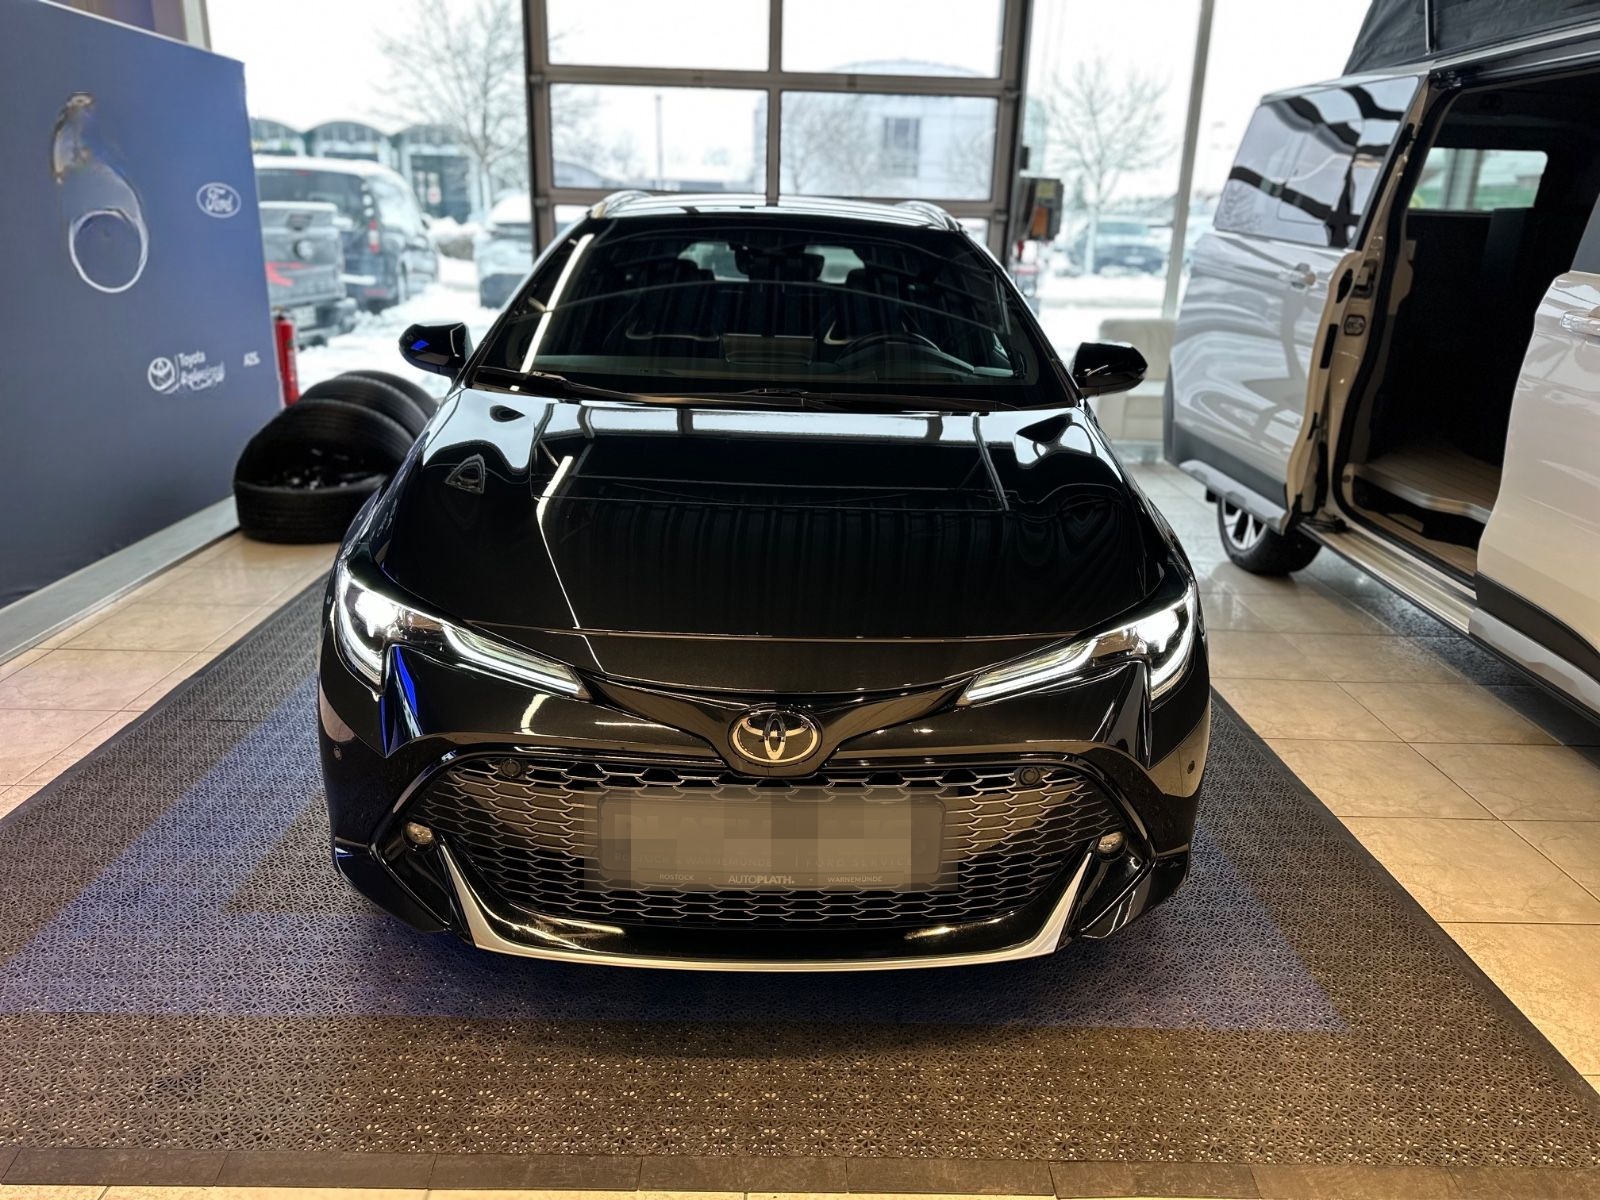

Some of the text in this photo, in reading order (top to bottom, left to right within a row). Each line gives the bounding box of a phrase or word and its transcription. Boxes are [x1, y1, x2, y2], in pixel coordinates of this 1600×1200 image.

[614, 852, 671, 864] ROSTOCK
[806, 857, 913, 868] FORD SERVICE
[659, 873, 695, 881] ROSTOCK
[827, 874, 883, 883] WARNEMÜNDE
